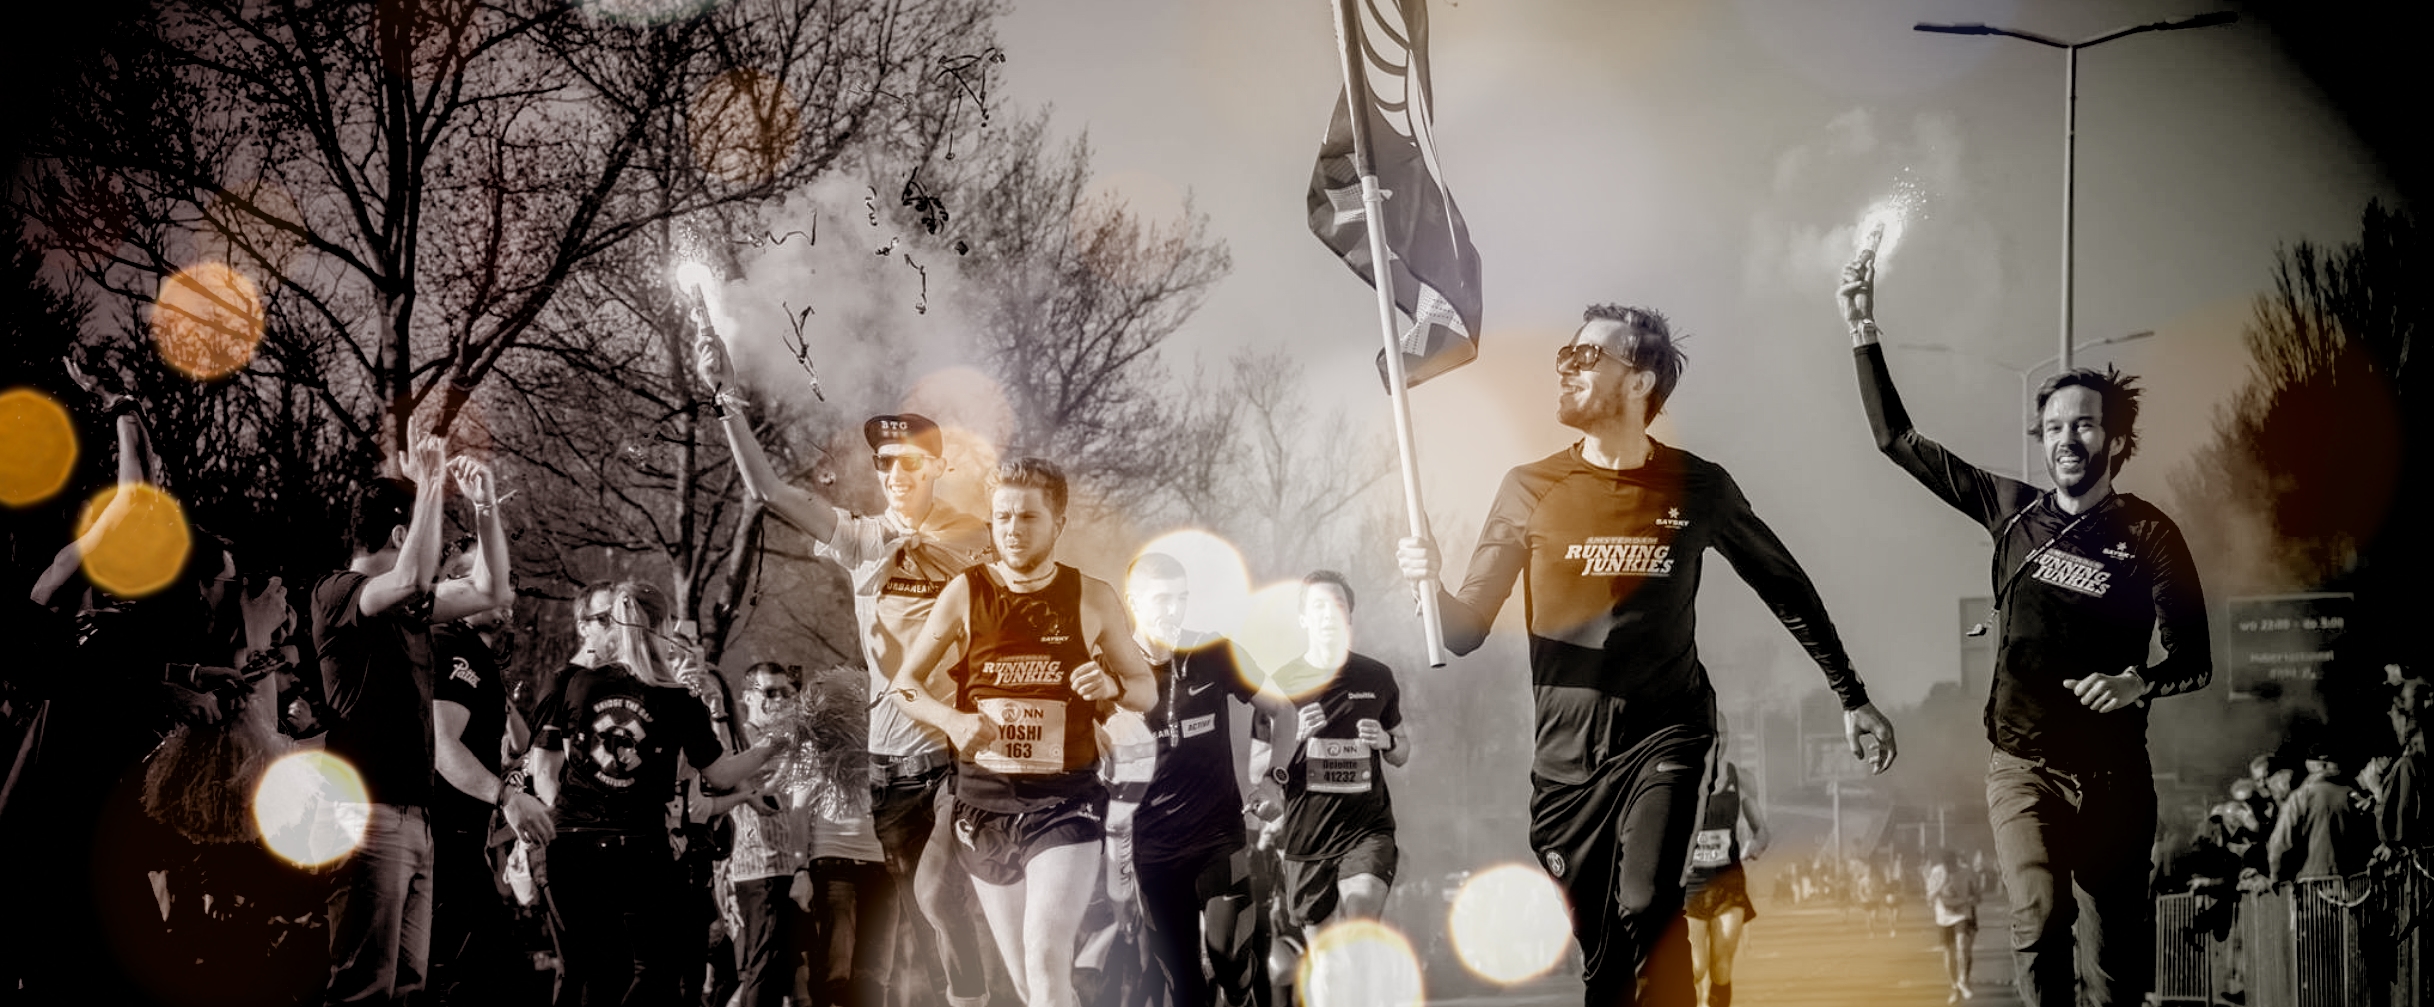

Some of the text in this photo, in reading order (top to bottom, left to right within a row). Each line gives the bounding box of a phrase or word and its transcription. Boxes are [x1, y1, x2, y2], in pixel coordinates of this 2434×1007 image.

[1565, 544, 1671, 560] RUNNING
[1581, 559, 1675, 576] JUNKIES
[2031, 565, 2111, 595] JUNKIES
[982, 661, 1062, 673] RUNNING
[993, 671, 1065, 686] JUNKIES
[1023, 708, 1045, 719] NN
[998, 724, 1043, 741] YOSHI
[1005, 742, 1033, 758] 163
[1323, 771, 1356, 782] 41232
